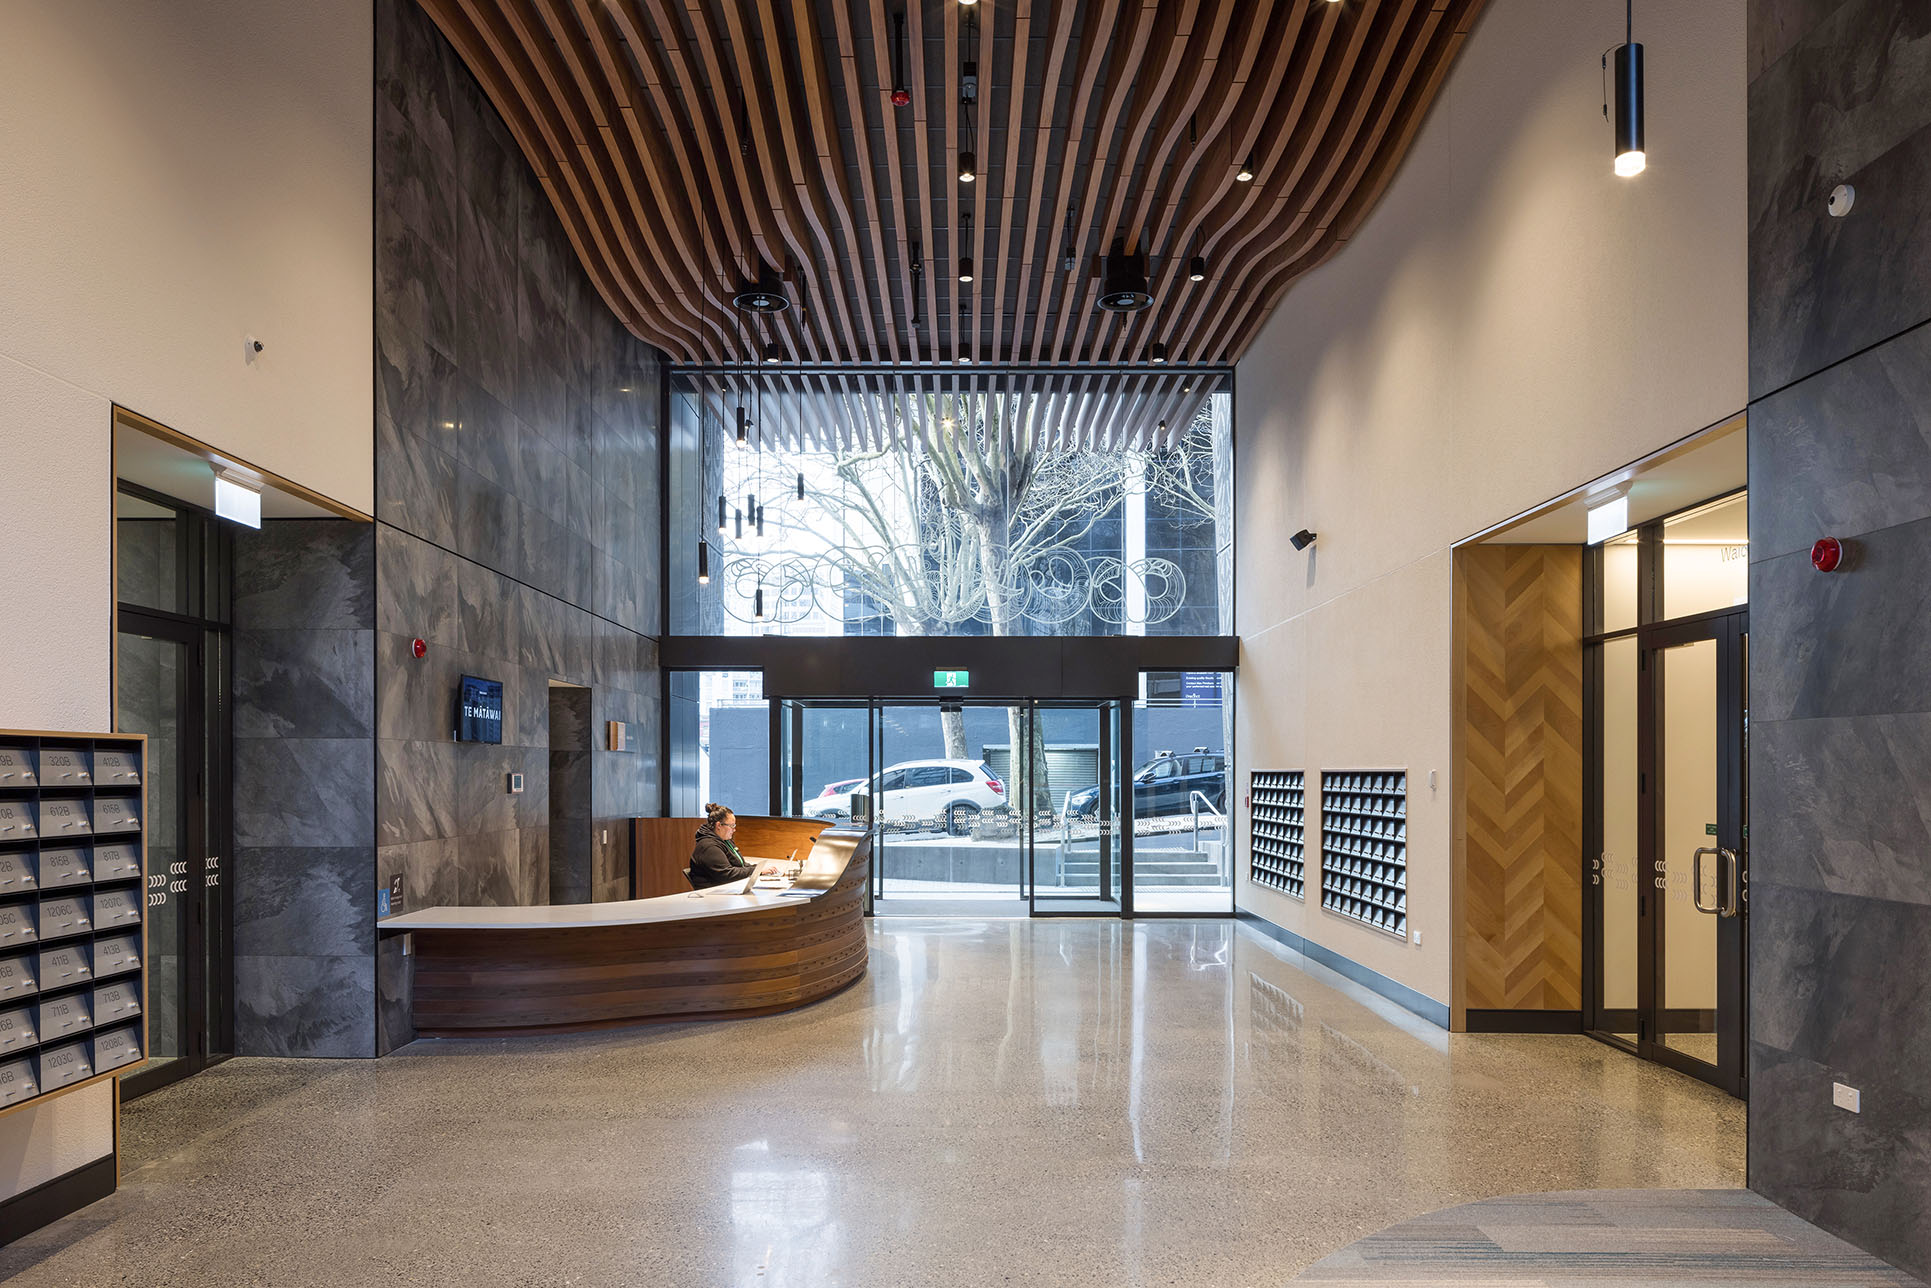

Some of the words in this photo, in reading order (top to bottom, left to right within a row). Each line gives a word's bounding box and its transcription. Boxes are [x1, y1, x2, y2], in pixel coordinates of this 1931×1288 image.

[464, 706, 472, 717] TE
[474, 705, 501, 720] MĀTĀWAI
[0, 755, 13, 767] 9B
[49, 756, 71, 767] 320B
[102, 756, 120, 767] 412B
[0, 808, 14, 820] 0B
[50, 806, 70, 817] 612B
[102, 804, 120, 814] 615B
[50, 856, 70, 868] 815B
[104, 850, 120, 862] 817B
[100, 897, 122, 910] 1207C
[47, 904, 72, 918] 1206C
[103, 944, 120, 956] 413B
[52, 954, 70, 967] 411B
[0, 965, 14, 980] 6B
[104, 990, 120, 1004] 713B
[0, 1018, 14, 1032] 6B
[48, 1052, 74, 1069] 1203C
[0, 1070, 14, 1084] 6B
